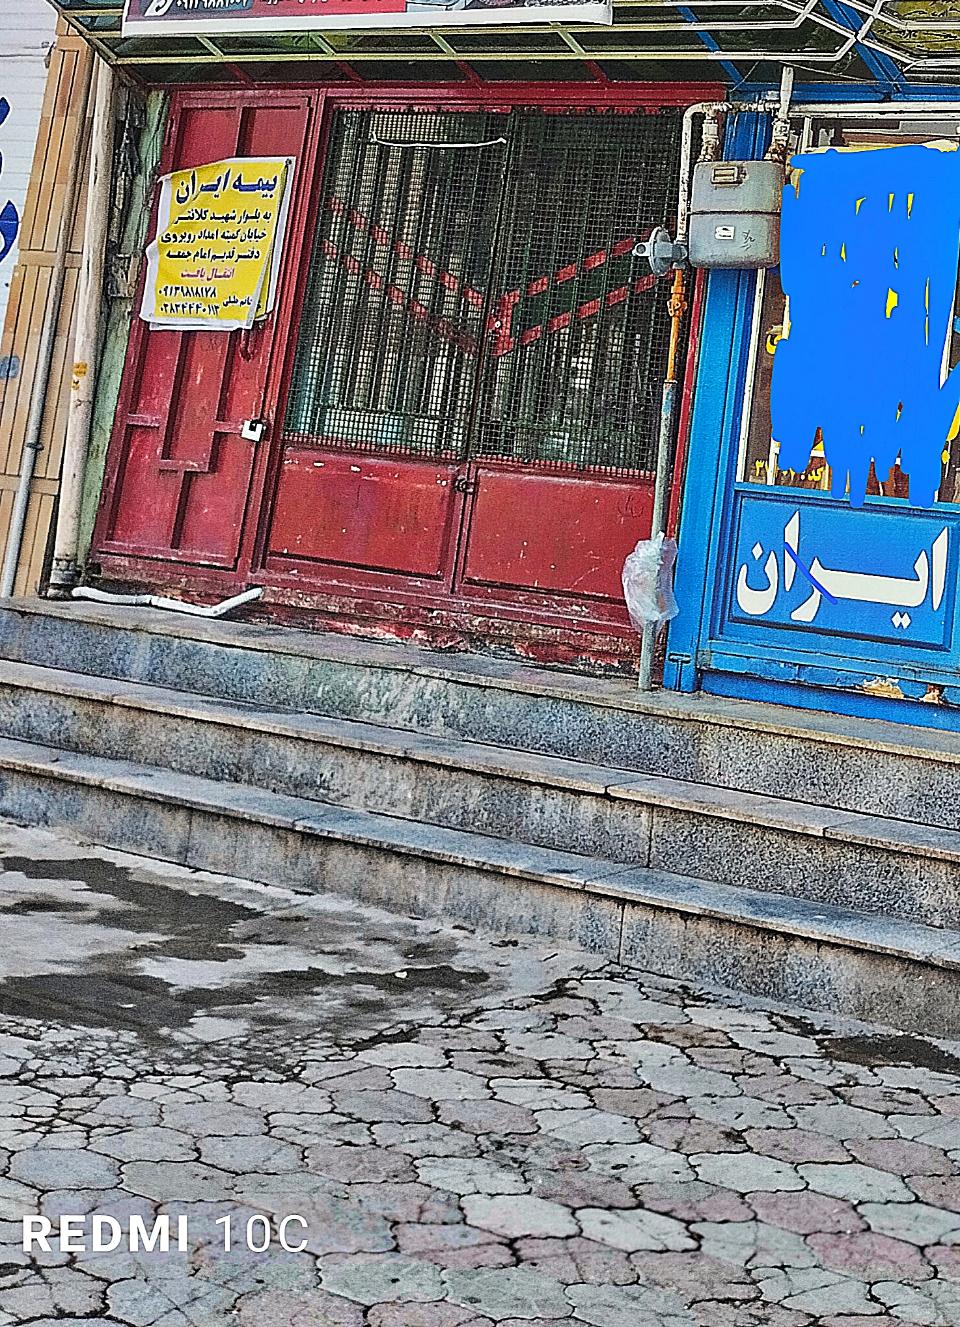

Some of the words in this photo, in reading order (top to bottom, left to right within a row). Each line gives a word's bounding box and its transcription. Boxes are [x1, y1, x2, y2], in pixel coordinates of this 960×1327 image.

[176, 168, 231, 204] ایران
[232, 172, 278, 199] بیمه
[210, 209, 237, 223] شهید
[237, 208, 260, 224] بلوار
[263, 211, 272, 223] به
[161, 231, 196, 243] روبروی
[197, 228, 219, 240] امداد
[220, 229, 241, 243] کمیته
[240, 228, 267, 242] خیابان
[166, 249, 191, 262] جمعه
[193, 248, 211, 262] امام
[210, 247, 236, 262] قدیم
[235, 248, 260, 262] دفتر
[180, 268, 206, 280] یافت
[207, 268, 235, 281] انتقال
[737, 510, 948, 630] ایران
